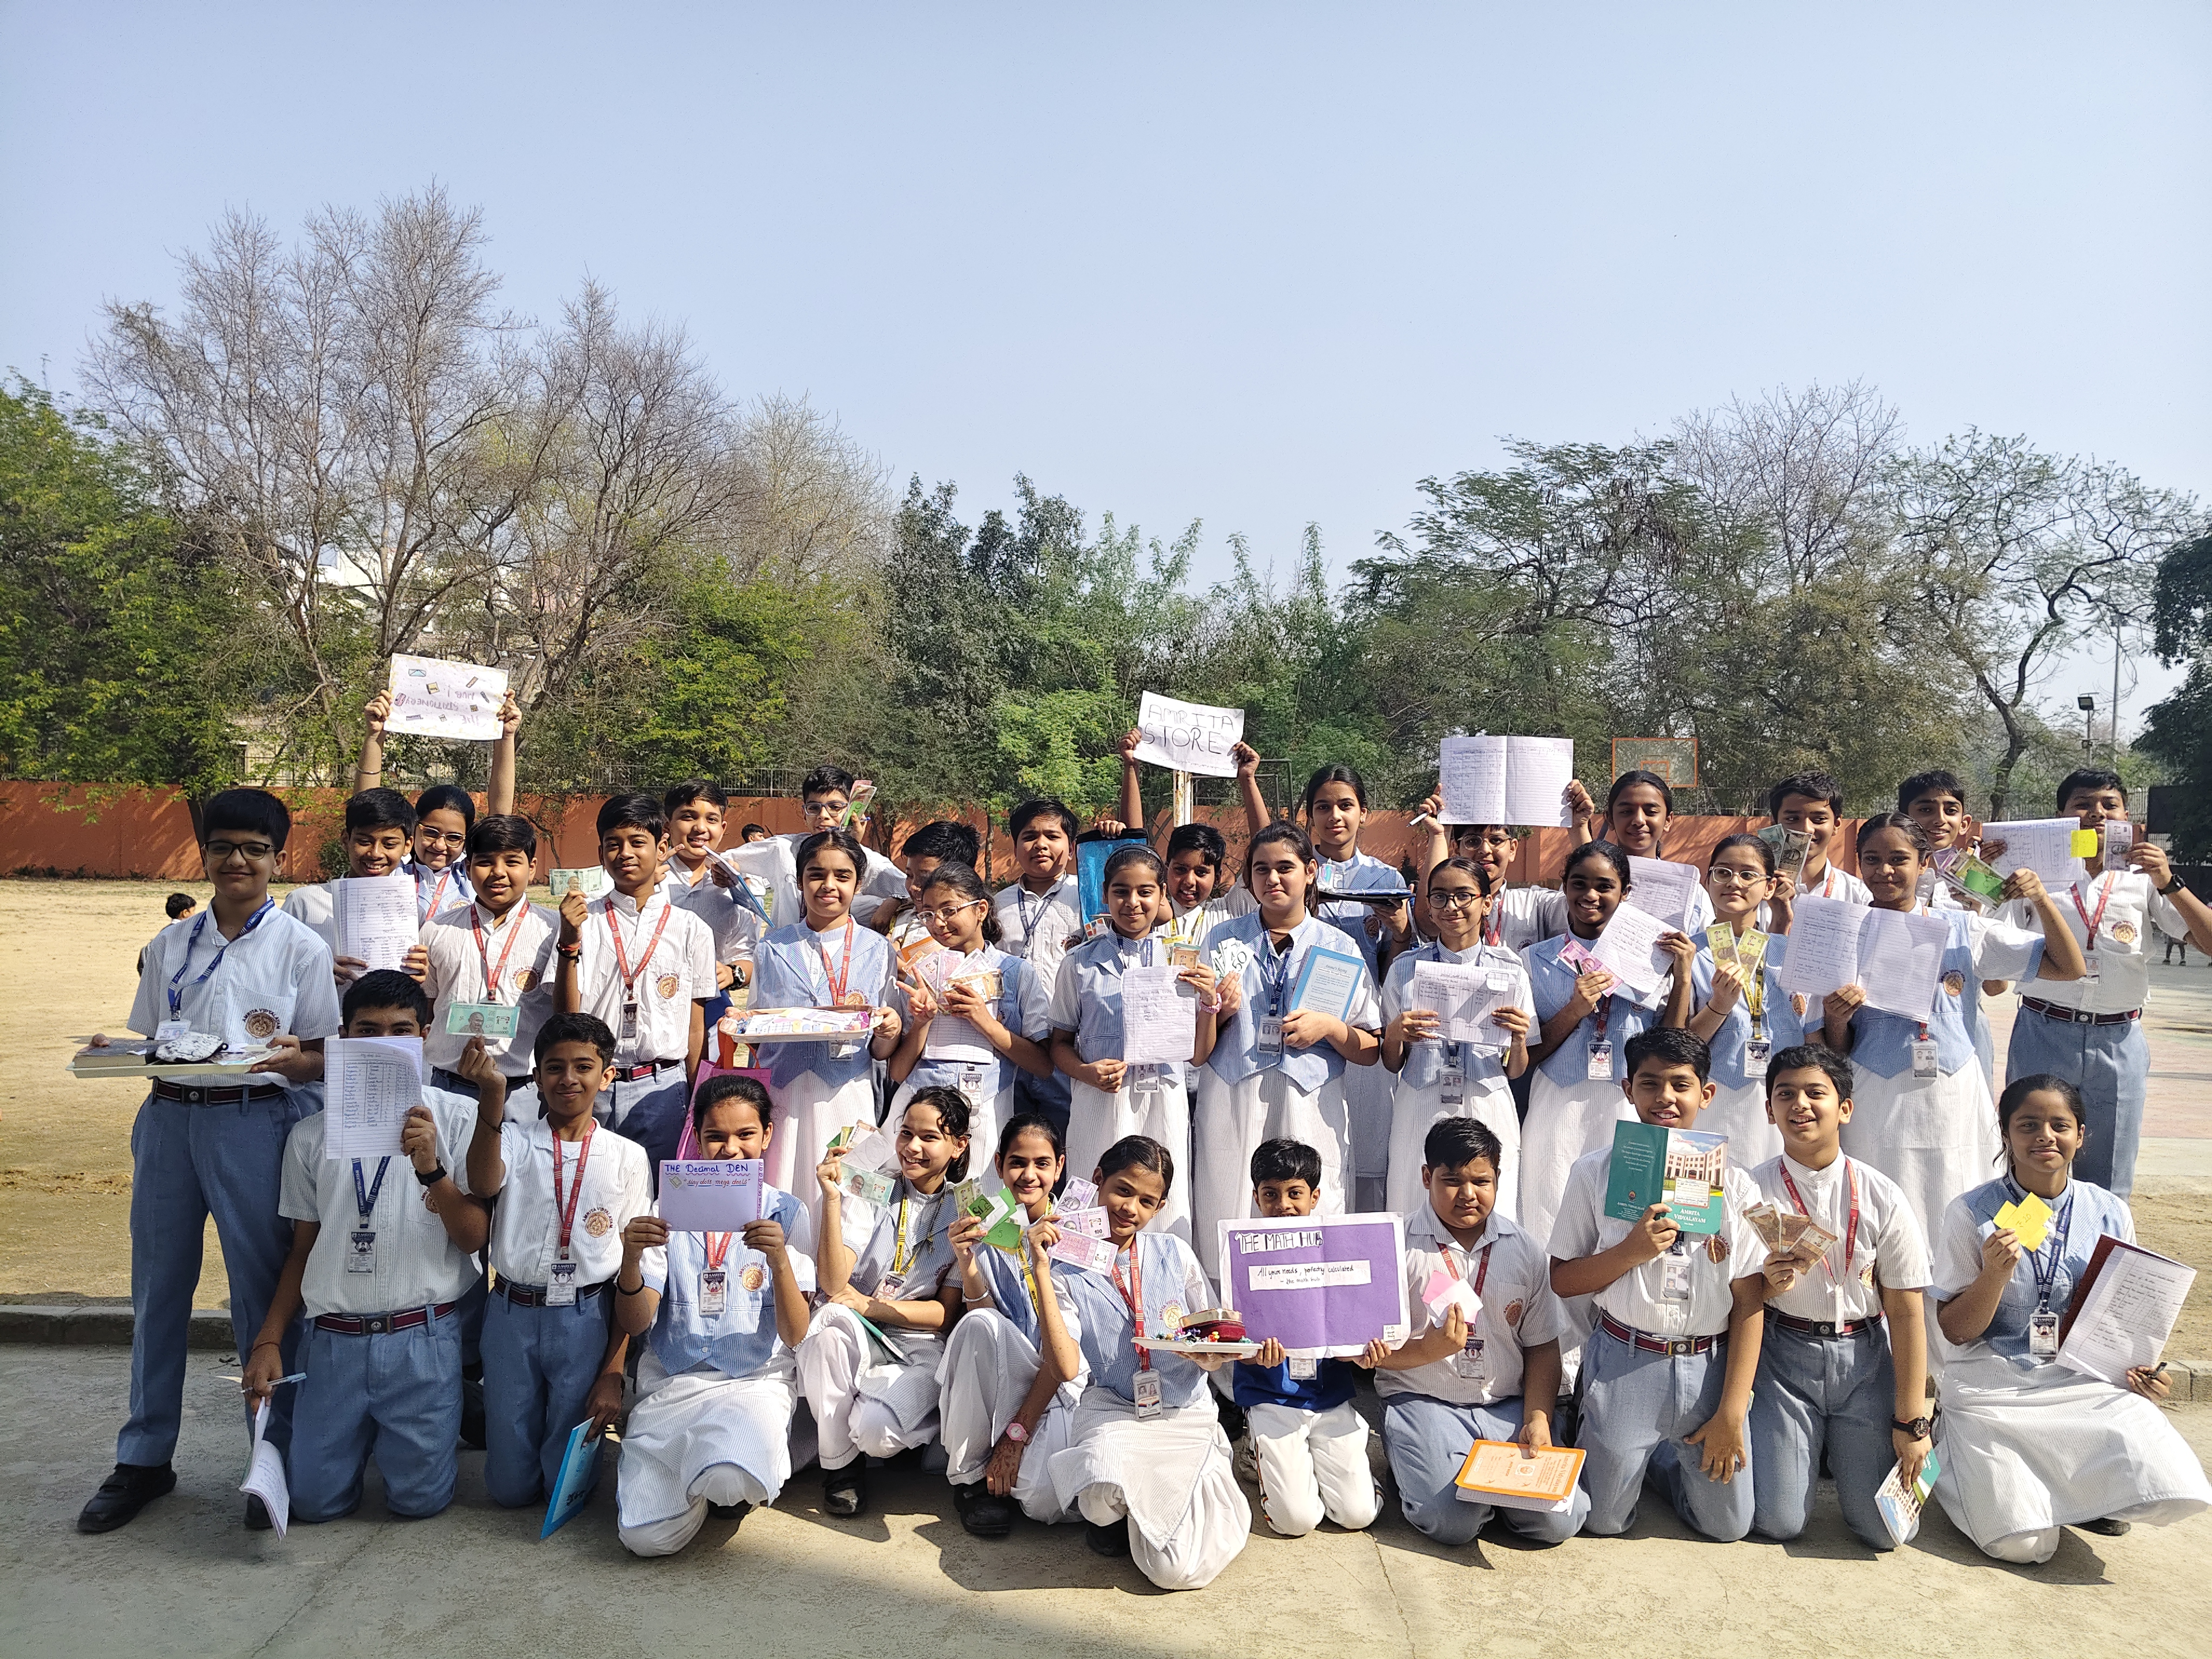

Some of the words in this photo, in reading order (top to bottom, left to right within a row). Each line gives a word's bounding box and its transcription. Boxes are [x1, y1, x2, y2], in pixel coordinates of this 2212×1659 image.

[1148, 704, 1234, 732] AMRITA
[1144, 722, 1222, 755] STORE
[1232, 951, 1247, 972] 50
[512, 967, 524, 980] AMRITA
[243, 1009, 258, 1023] AMRITA
[259, 1008, 281, 1029] VIDYALAYAM
[665, 1164, 681, 1173] THE
[685, 1164, 720, 1173] Decimal
[725, 1163, 748, 1173] DEN
[571, 1187, 579, 1210] VIDYALAYAM
[582, 1207, 597, 1223] AMRITA
[597, 1207, 614, 1229] VIDYALAYAM
[1673, 1213, 1706, 1224] VIDYALAYAM
[1680, 1208, 1700, 1217] AMRITA
[997, 1230, 1003, 1238] 5
[1241, 1233, 1260, 1253] THE
[1265, 1232, 1294, 1251] MATH
[1300, 1231, 1324, 1247] HUB
[1132, 1268, 1142, 1291] VIDYALAYAM
[1257, 1266, 1267, 1277] All
[1328, 1264, 1354, 1274] calculated
[1503, 1300, 1516, 1314] AMRITA
[1563, 1454, 1571, 1469] Amrita
[1552, 1468, 1567, 1493] Vidyalayam
